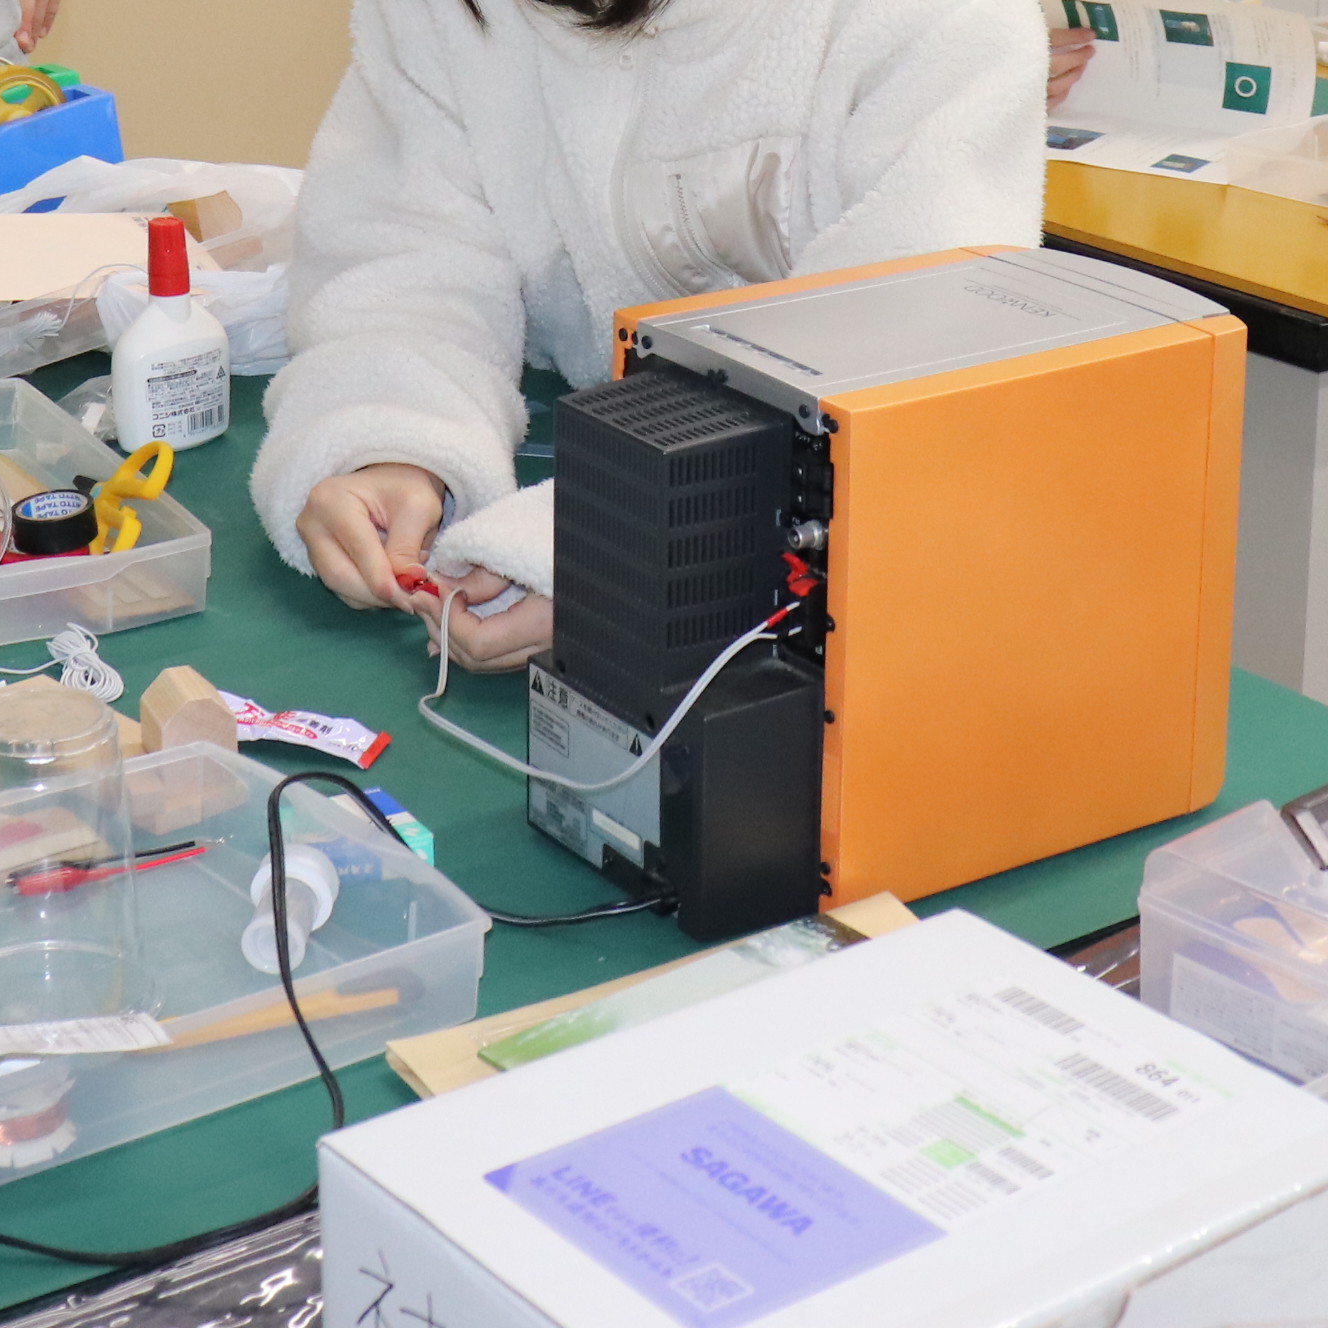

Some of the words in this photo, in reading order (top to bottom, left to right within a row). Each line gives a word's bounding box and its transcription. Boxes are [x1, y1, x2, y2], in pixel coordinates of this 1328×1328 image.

[35, 501, 59, 512] TAPE
[36, 509, 60, 520] TAPE
[546, 676, 569, 711] 注意
[1135, 1062, 1180, 1089] 864
[680, 1145, 814, 1236] SAGAWA
